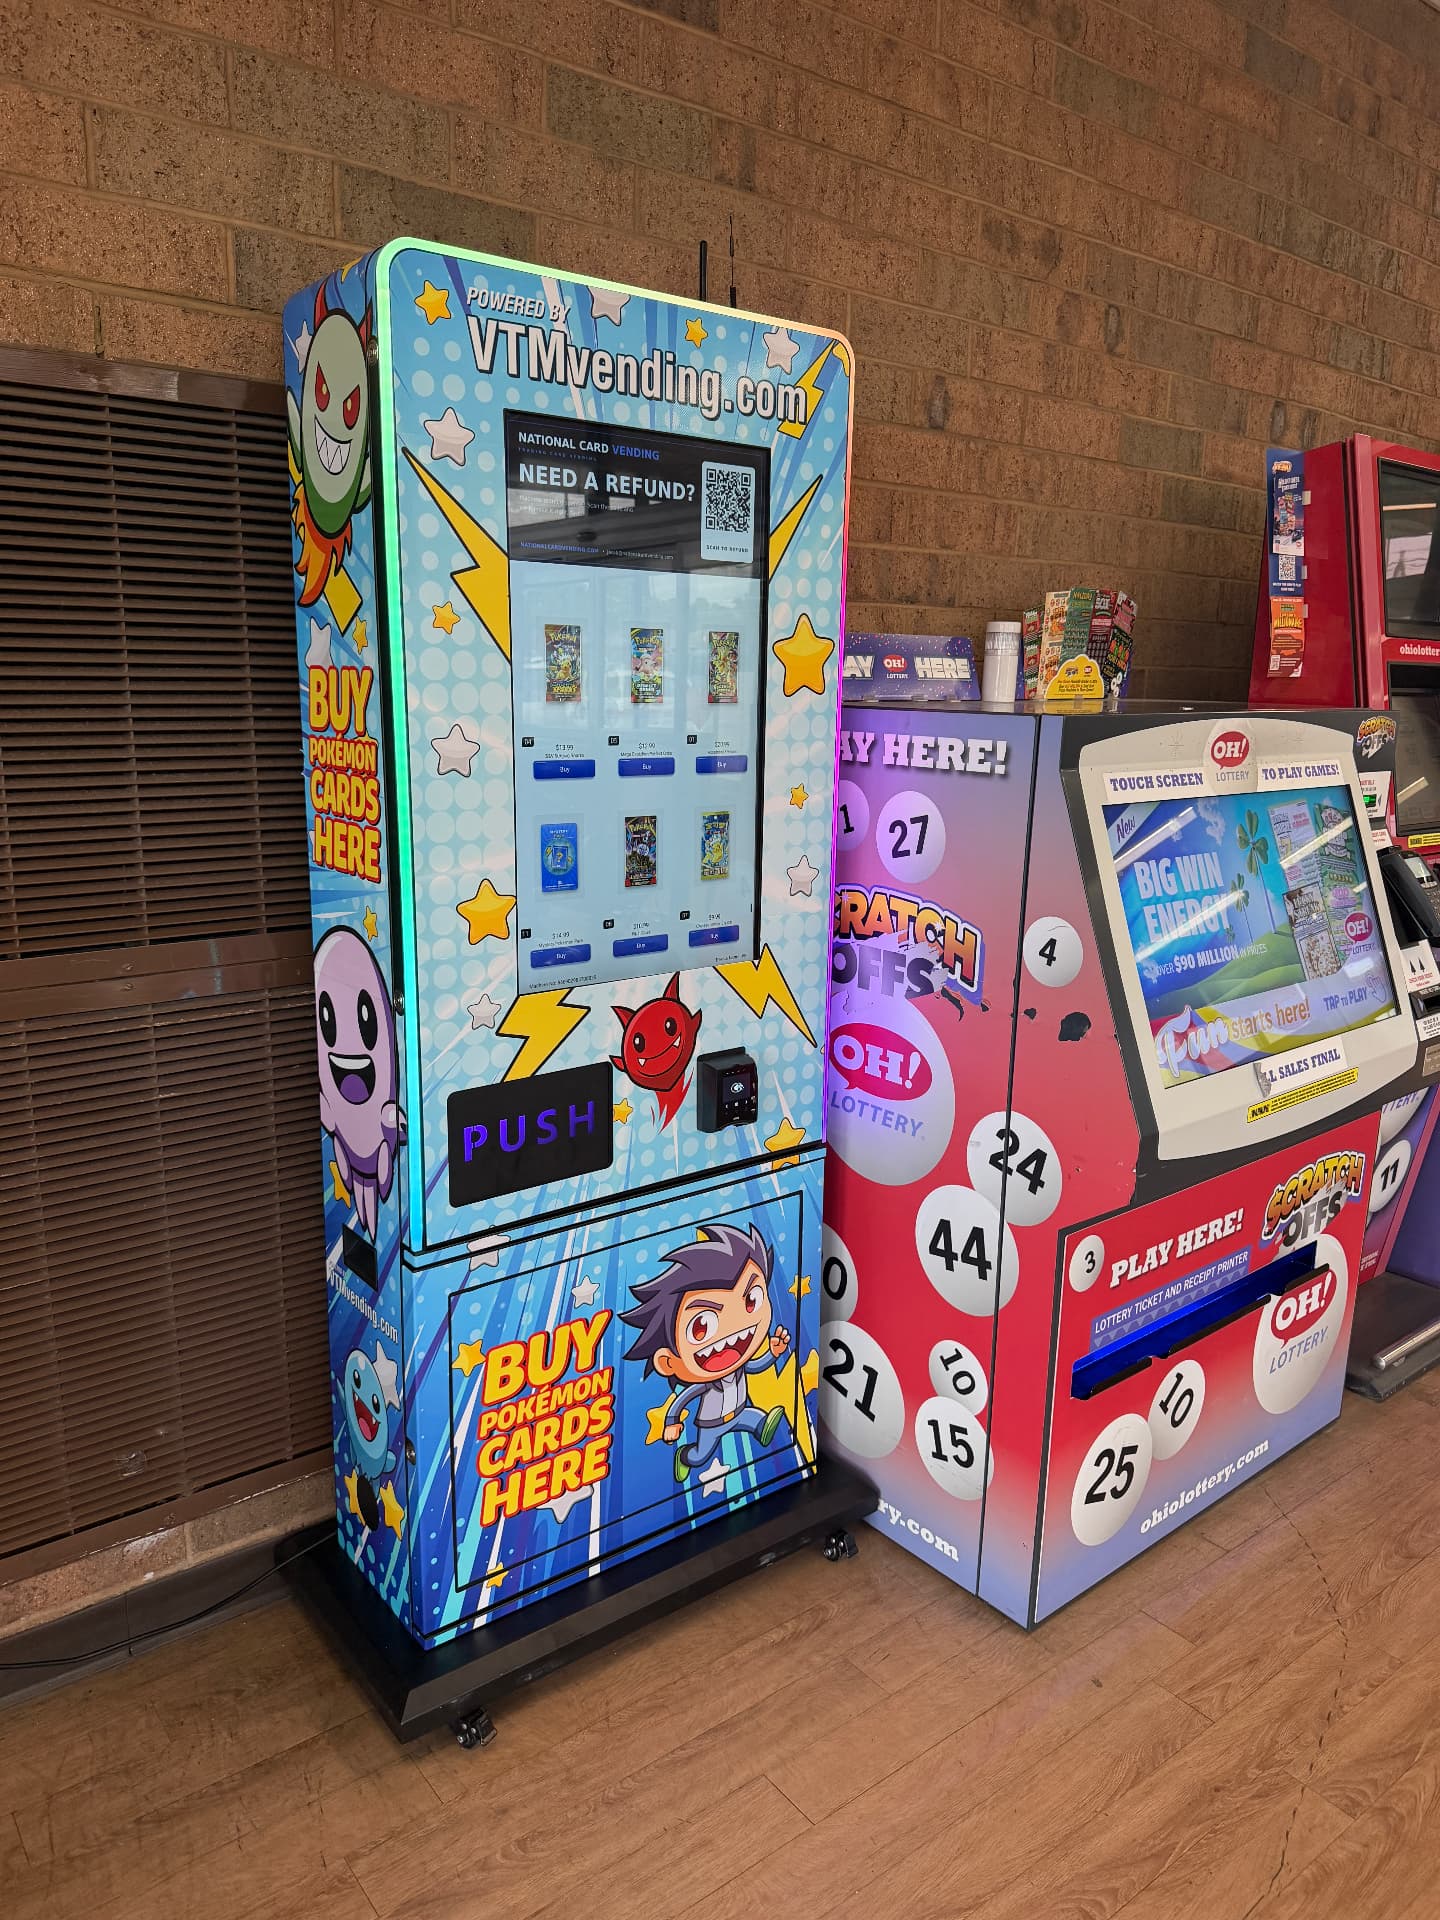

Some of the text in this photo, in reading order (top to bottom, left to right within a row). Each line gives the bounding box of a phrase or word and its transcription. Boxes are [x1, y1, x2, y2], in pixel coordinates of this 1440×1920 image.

[467, 287, 571, 323] POWERED BY
[467, 315, 808, 426] VTMvending.com
[518, 431, 577, 451] NATIONAL
[578, 440, 610, 454] CARD
[612, 445, 660, 461] VENDING
[519, 463, 696, 502] NEED A REFUND?
[884, 657, 905, 669] OH!
[886, 672, 909, 680] LOTTERY
[914, 656, 972, 680] HERE
[308, 665, 374, 737] BUY
[882, 733, 1008, 775] HERE!
[1213, 738, 1248, 759] OH!
[1358, 717, 1396, 742] SCRATCH
[309, 733, 378, 777] POKÉMON
[1215, 769, 1250, 782] LOTTERY
[1261, 763, 1340, 780] TO PLAY GAMES!
[310, 767, 381, 826] CARDS
[1110, 772, 1204, 792] TOUCH SCREEN
[313, 815, 382, 884] HERE
[888, 815, 930, 858] 27
[1116, 817, 1137, 843] New
[1133, 851, 1225, 900] BIG WIN
[1142, 896, 1233, 944] ENERGY
[1346, 917, 1369, 935] OH!
[1038, 938, 1058, 967] 4
[1174, 953, 1196, 974] $90
[1196, 945, 1240, 968] MILLION
[1323, 996, 1340, 1011] TAP
[1348, 988, 1368, 1008] PLAY
[833, 1034, 921, 1090] OH!
[1155, 998, 1312, 1078] Fun starts here!
[1278, 1058, 1310, 1080] SALES
[1310, 1048, 1341, 1069] FINAL
[463, 1100, 596, 1163] PUSH
[831, 1090, 925, 1139] LOTTERY
[988, 1128, 1048, 1196] 24
[1381, 1158, 1400, 1193] 11
[1264, 1152, 1366, 1238] SCRATCH
[1284, 1188, 1346, 1248] OFFS
[929, 1218, 992, 1281] 44
[1084, 1250, 1096, 1275] 3
[1109, 1208, 1246, 1288] PLAY HERE!
[1094, 1250, 1249, 1333] LOTTERY TICKET AND RECEIPT PRINTER
[1275, 1271, 1332, 1331] OH!
[481, 1308, 613, 1407] BUY
[939, 1347, 976, 1396] 10
[1270, 1326, 1328, 1375] LOTTERY
[477, 1367, 614, 1440] POKÉMON
[822, 1338, 880, 1422] 21
[1159, 1372, 1195, 1429] 10
[477, 1394, 615, 1479] CARDS
[928, 1418, 975, 1469] 15
[479, 1434, 613, 1527] HERE
[1083, 1445, 1139, 1505] 25
[1140, 1438, 1269, 1535] ohiolottery.com
